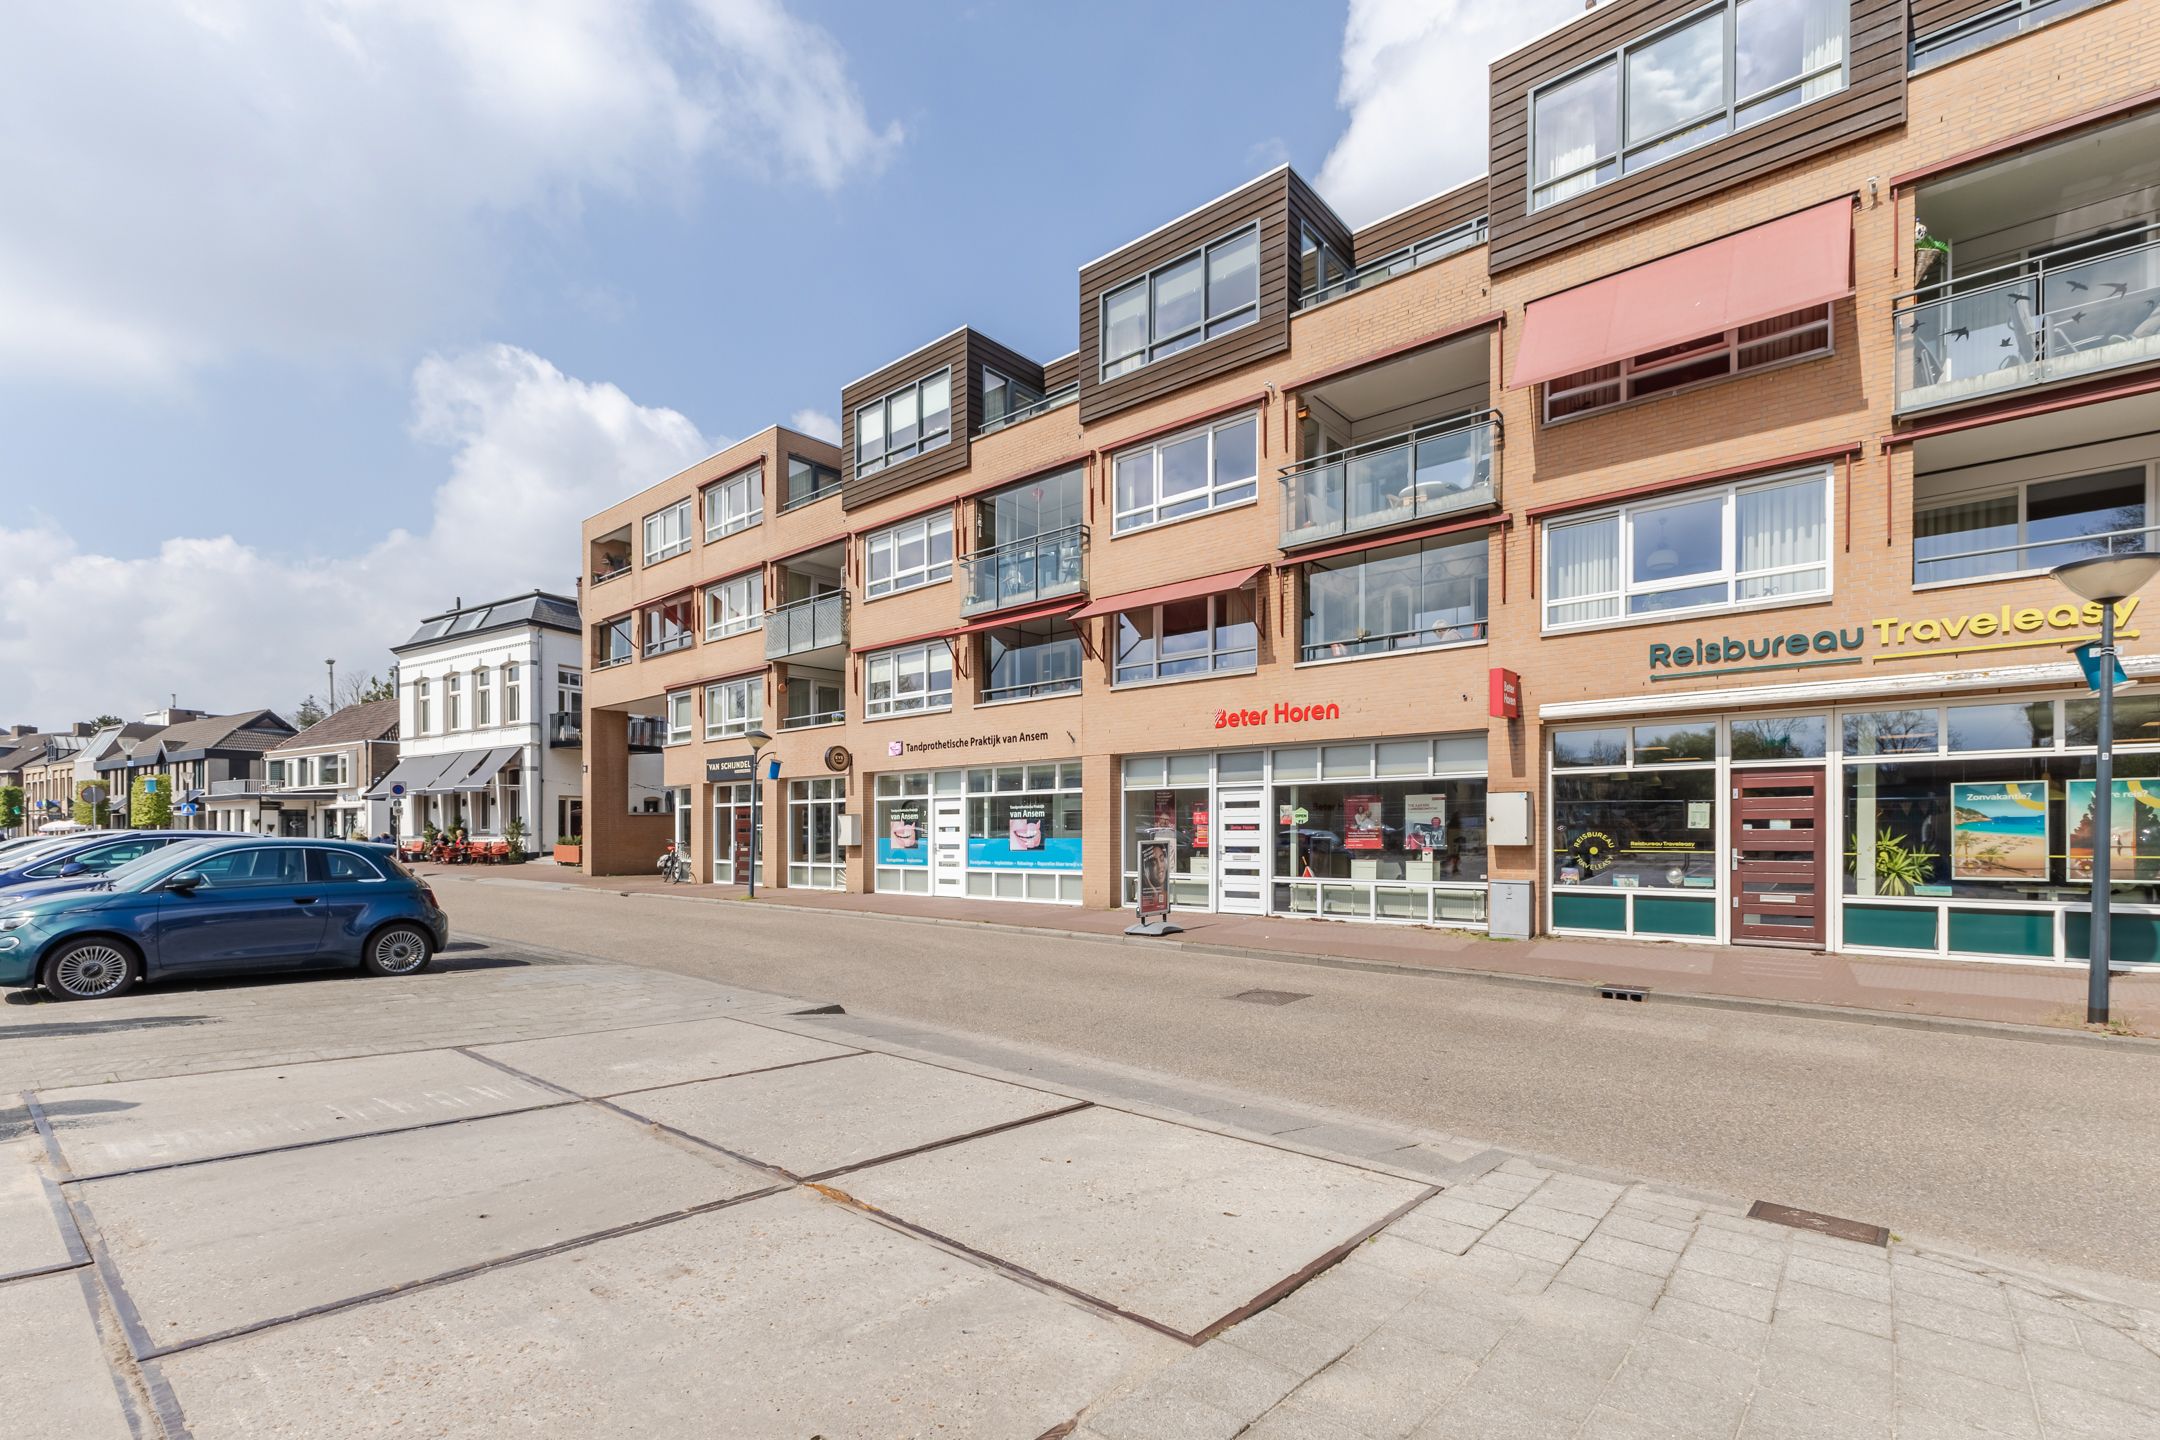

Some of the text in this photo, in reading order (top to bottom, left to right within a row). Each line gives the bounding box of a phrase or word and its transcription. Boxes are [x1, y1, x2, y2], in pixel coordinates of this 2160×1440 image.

[1650, 596, 2140, 669] Reisbureau Traveleasy
[1215, 702, 1340, 729] Beter Horen
[906, 731, 1049, 754] Tandprothetische Praktijk van Ansem
[708, 760, 751, 771] VAN SCHIJNDEL
[1966, 792, 2033, 801] Zonvakantie?
[901, 812, 919, 820] Ansem
[1022, 809, 1046, 818] Ansem
[1573, 831, 1616, 849] REISBUREAU
[1574, 854, 1614, 871] TRAVELEASY
